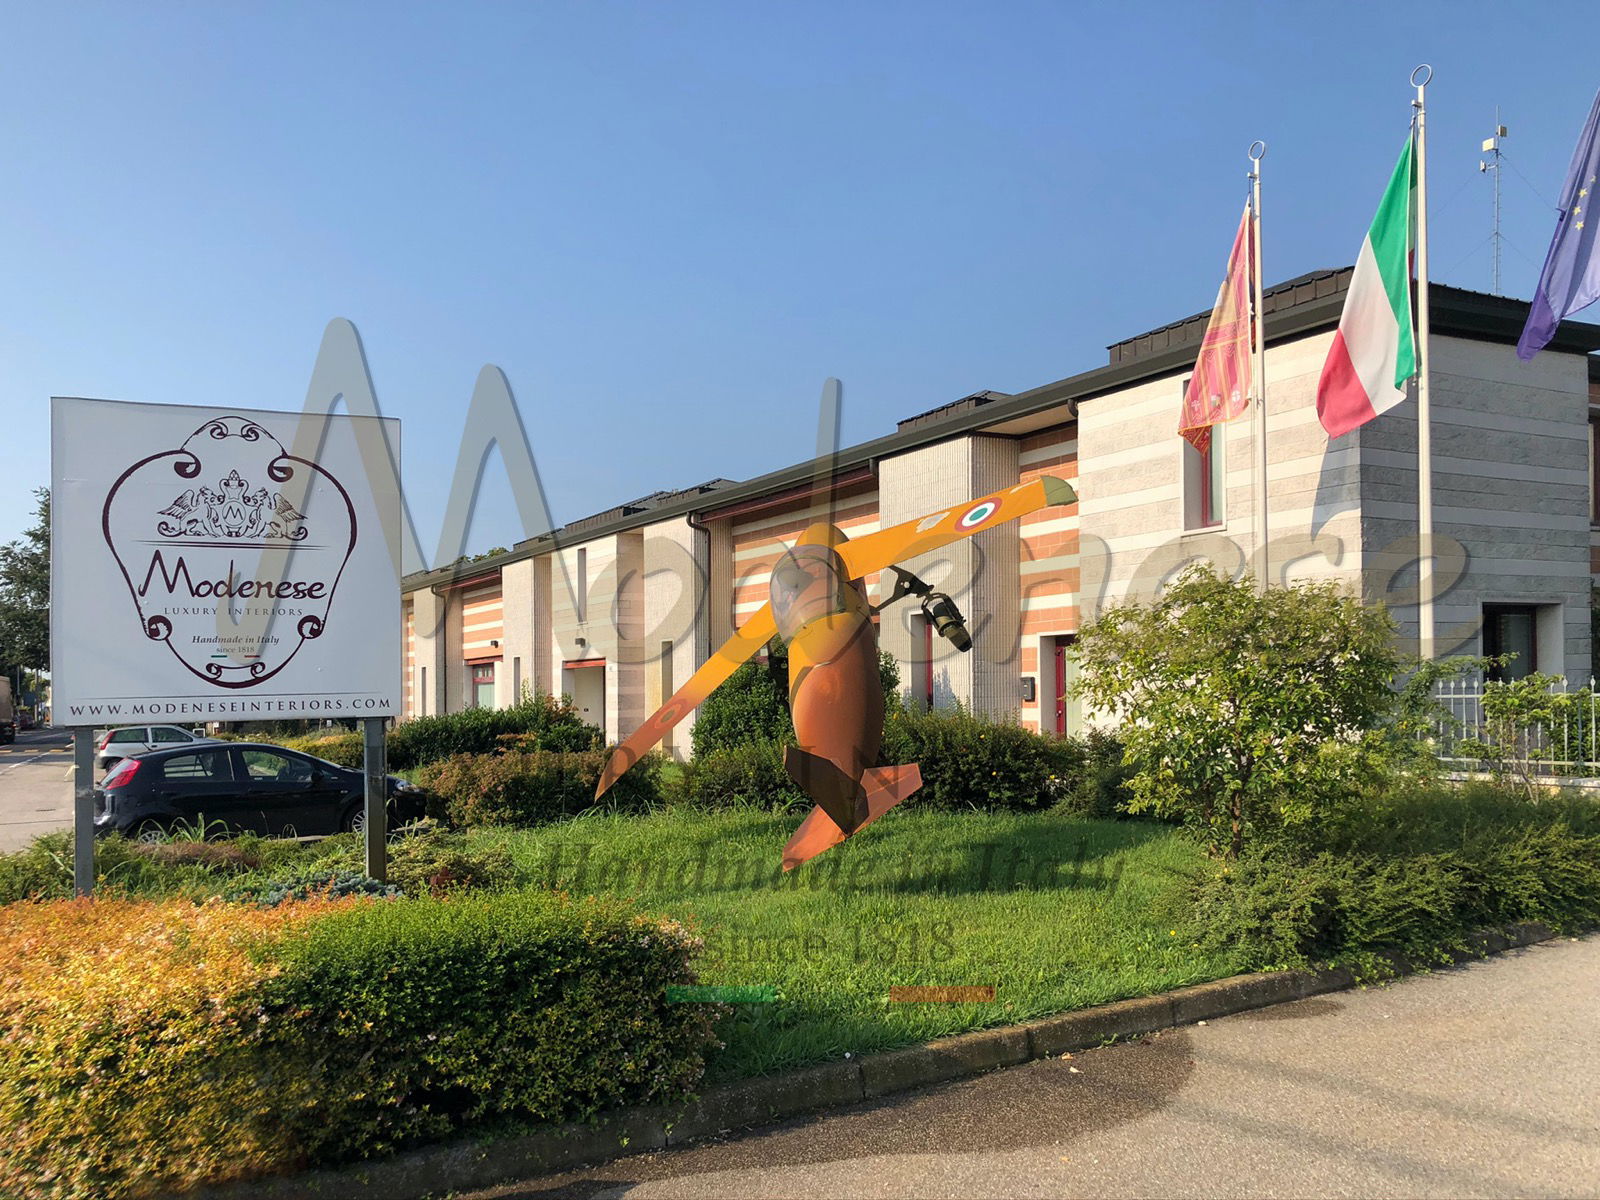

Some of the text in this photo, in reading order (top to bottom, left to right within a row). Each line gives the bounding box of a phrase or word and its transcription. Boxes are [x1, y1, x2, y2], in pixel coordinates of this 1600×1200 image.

[223, 505, 243, 520] M
[138, 549, 327, 599] Modenese
[164, 607, 303, 616] LUXURY INTERIORS
[192, 635, 280, 645] Handmade in Italy
[238, 645, 255, 653] 1818
[70, 698, 391, 716] WWW.MODENESEINTERIORS.COM
